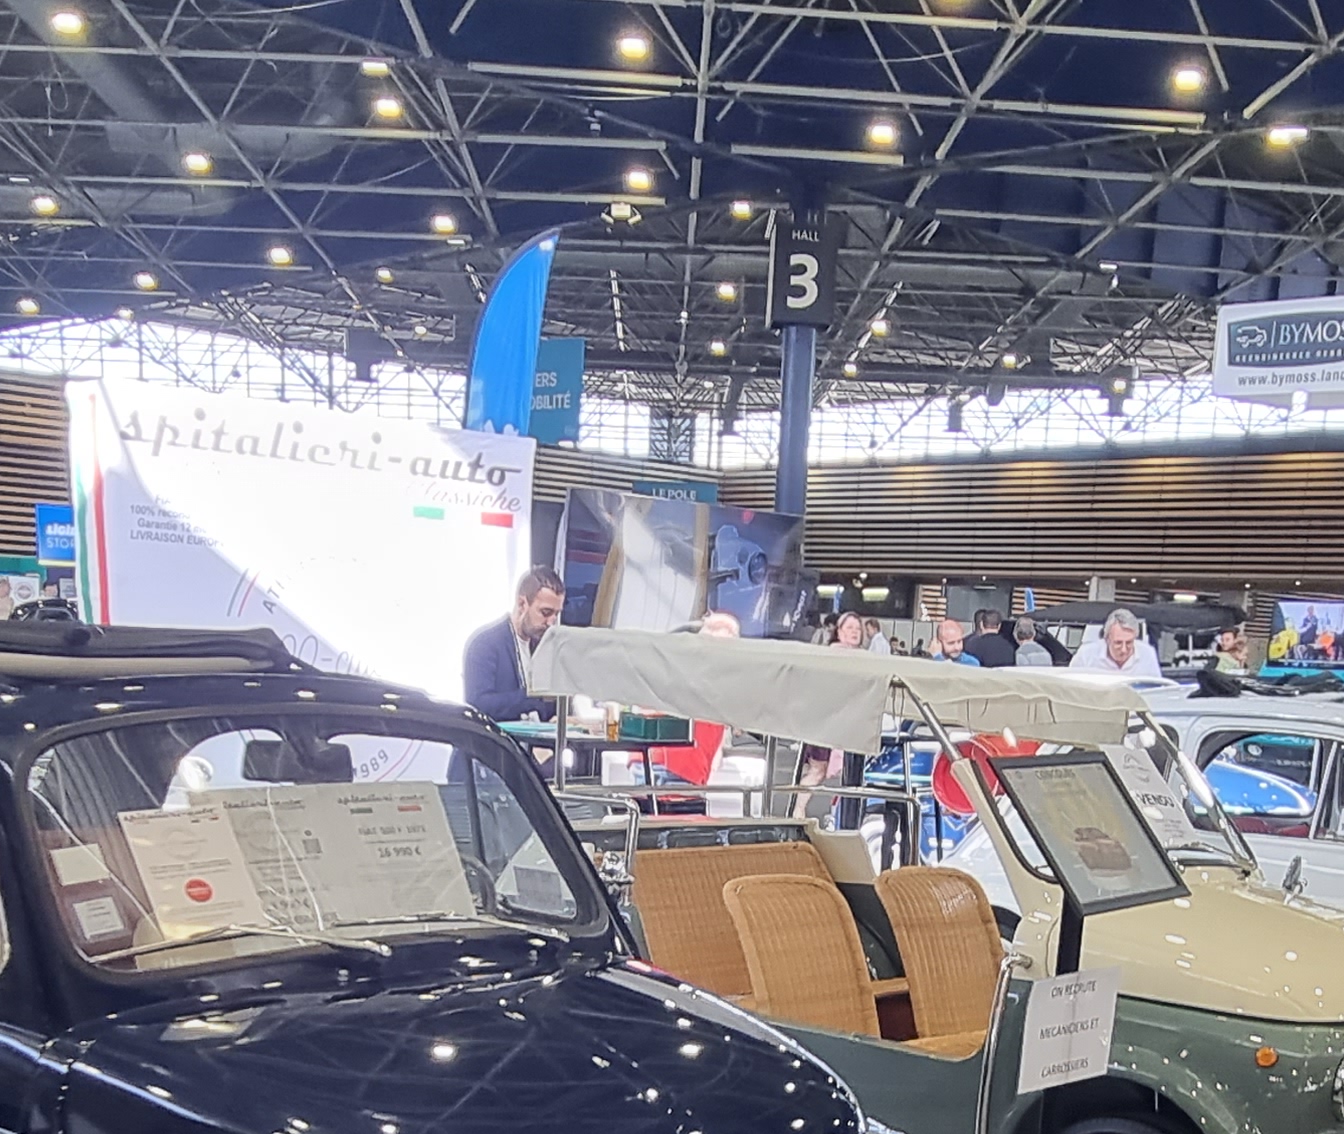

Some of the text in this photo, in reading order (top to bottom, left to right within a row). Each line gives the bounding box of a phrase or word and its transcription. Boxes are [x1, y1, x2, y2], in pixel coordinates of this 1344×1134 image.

[791, 229, 819, 242] HALL
[786, 254, 819, 309] 3
[535, 372, 557, 387] ERS
[530, 392, 571, 410] OBILITÉ
[121, 407, 522, 487] spitalieri-auto
[137, 518, 177, 532] Garantie
[47, 538, 75, 548] STO
[130, 530, 224, 547] LIVRAISON EURO
